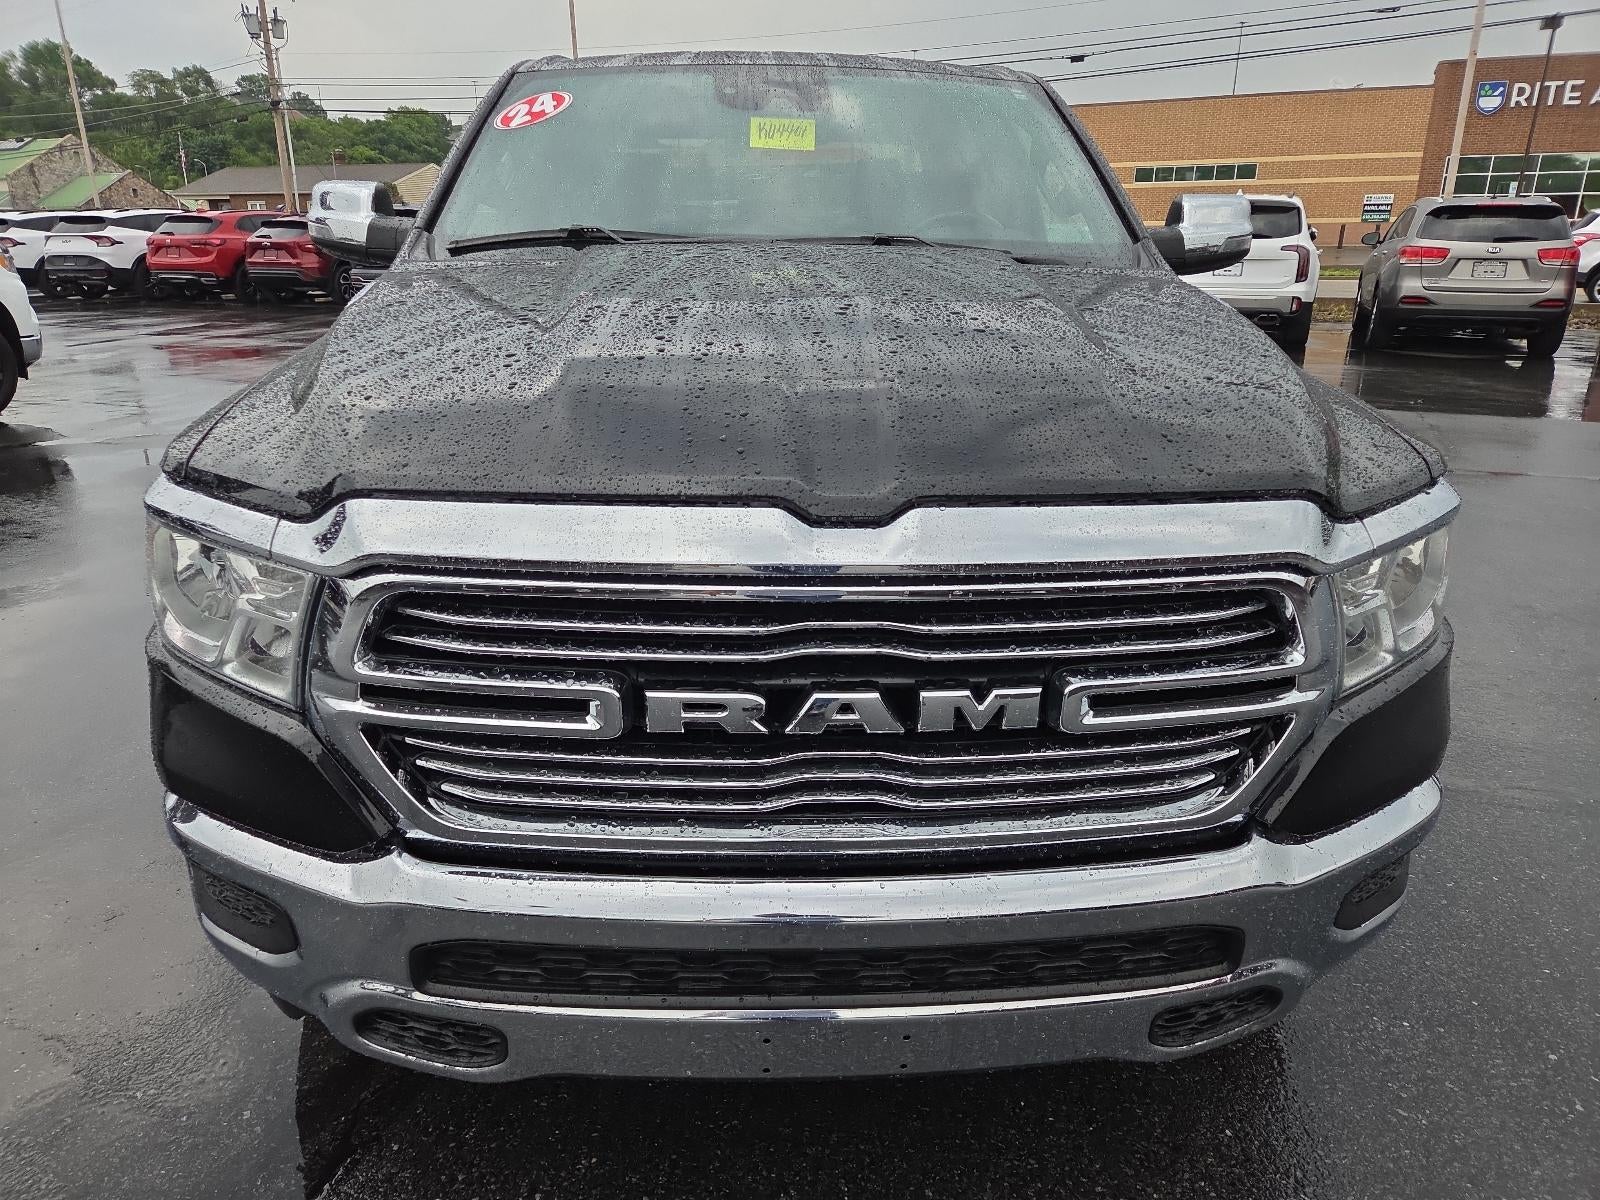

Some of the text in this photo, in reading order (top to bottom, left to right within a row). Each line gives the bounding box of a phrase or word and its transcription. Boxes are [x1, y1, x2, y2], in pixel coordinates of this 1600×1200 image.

[507, 93, 557, 127] 24
[1510, 80, 1585, 107] RITE
[644, 688, 1042, 734] RAM
